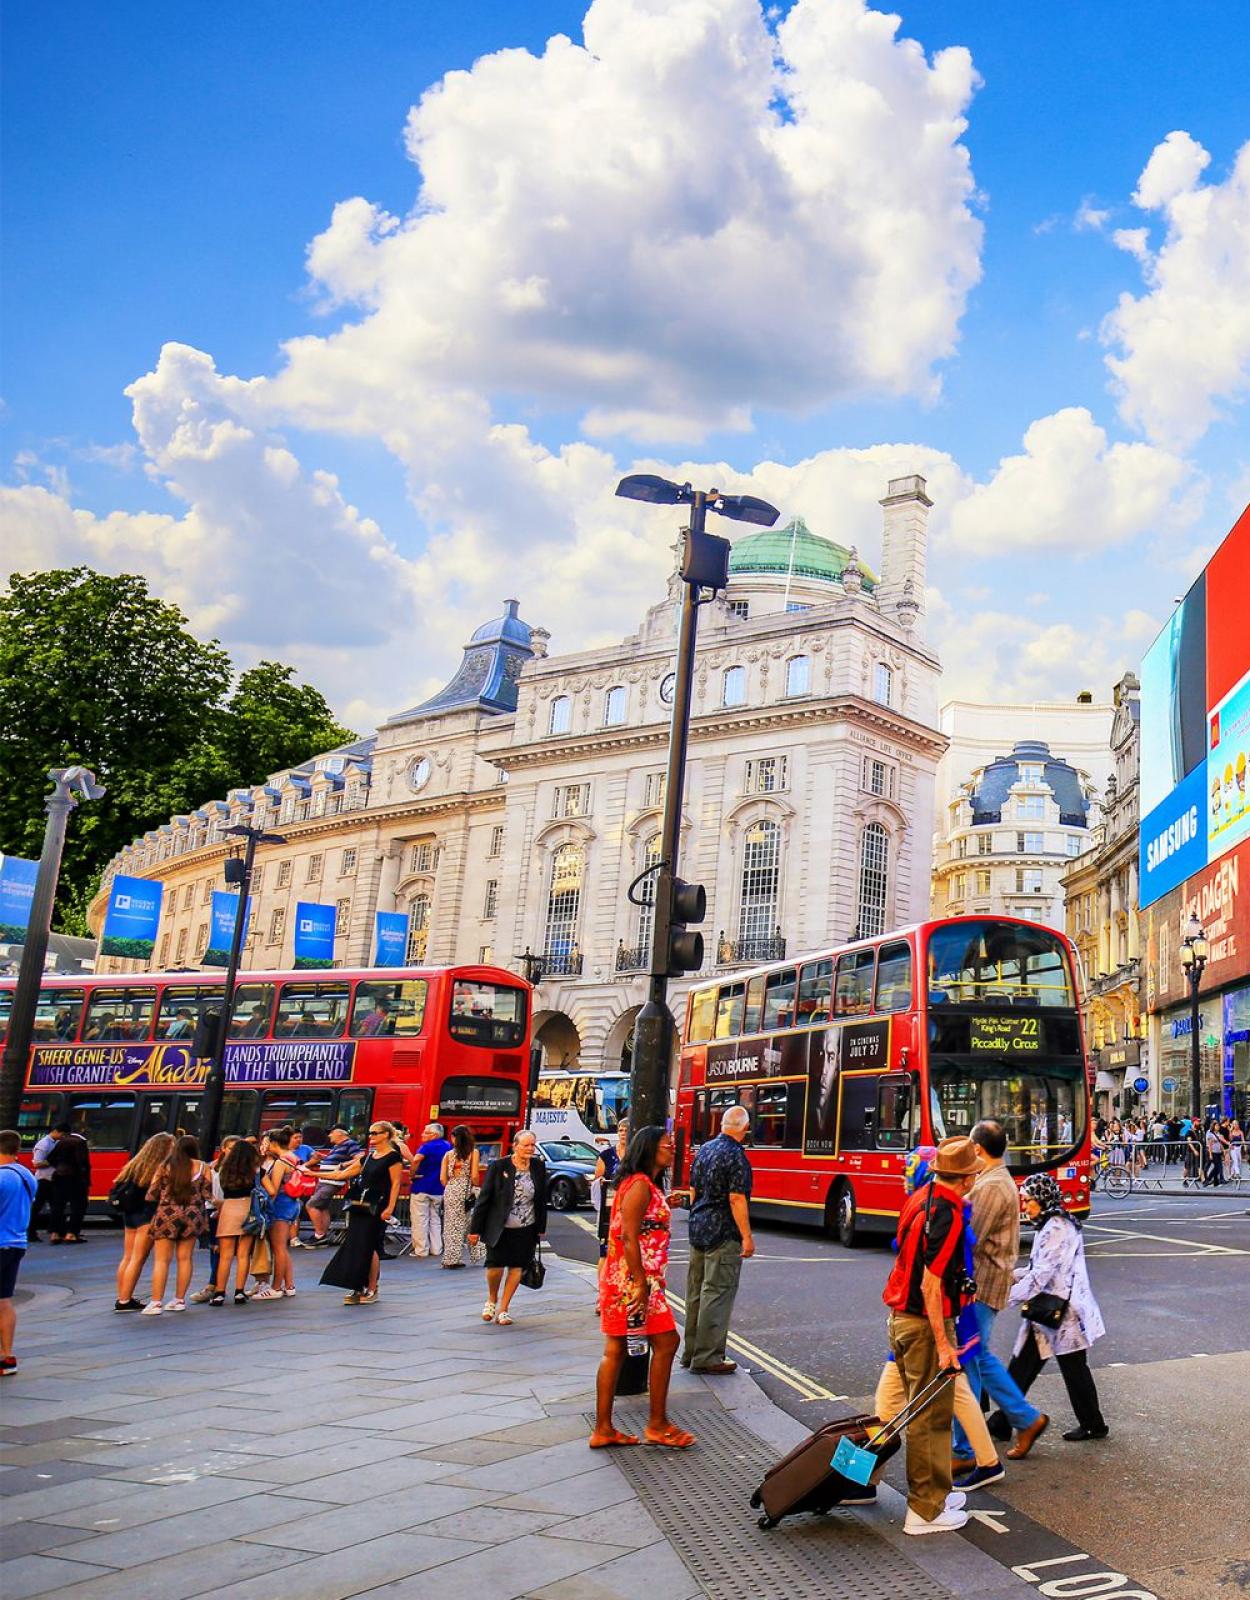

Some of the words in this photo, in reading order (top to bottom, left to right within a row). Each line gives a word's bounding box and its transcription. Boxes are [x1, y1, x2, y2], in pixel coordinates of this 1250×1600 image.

[1146, 804, 1198, 873] SAMSUNG
[1020, 1018, 1038, 1036] 22
[263, 1043, 348, 1062] TRIUMPHANTLY
[850, 1045, 868, 1058] JULY
[869, 1044, 879, 1056] 27
[971, 1036, 1010, 1052] Piccadilly
[1012, 1037, 1039, 1050] Circus
[113, 1045, 212, 1085] Aladdi
[225, 1062, 240, 1081] IN
[245, 1061, 271, 1080] THE
[275, 1060, 314, 1080] WEST
[535, 1110, 568, 1125] MAJESTIC
